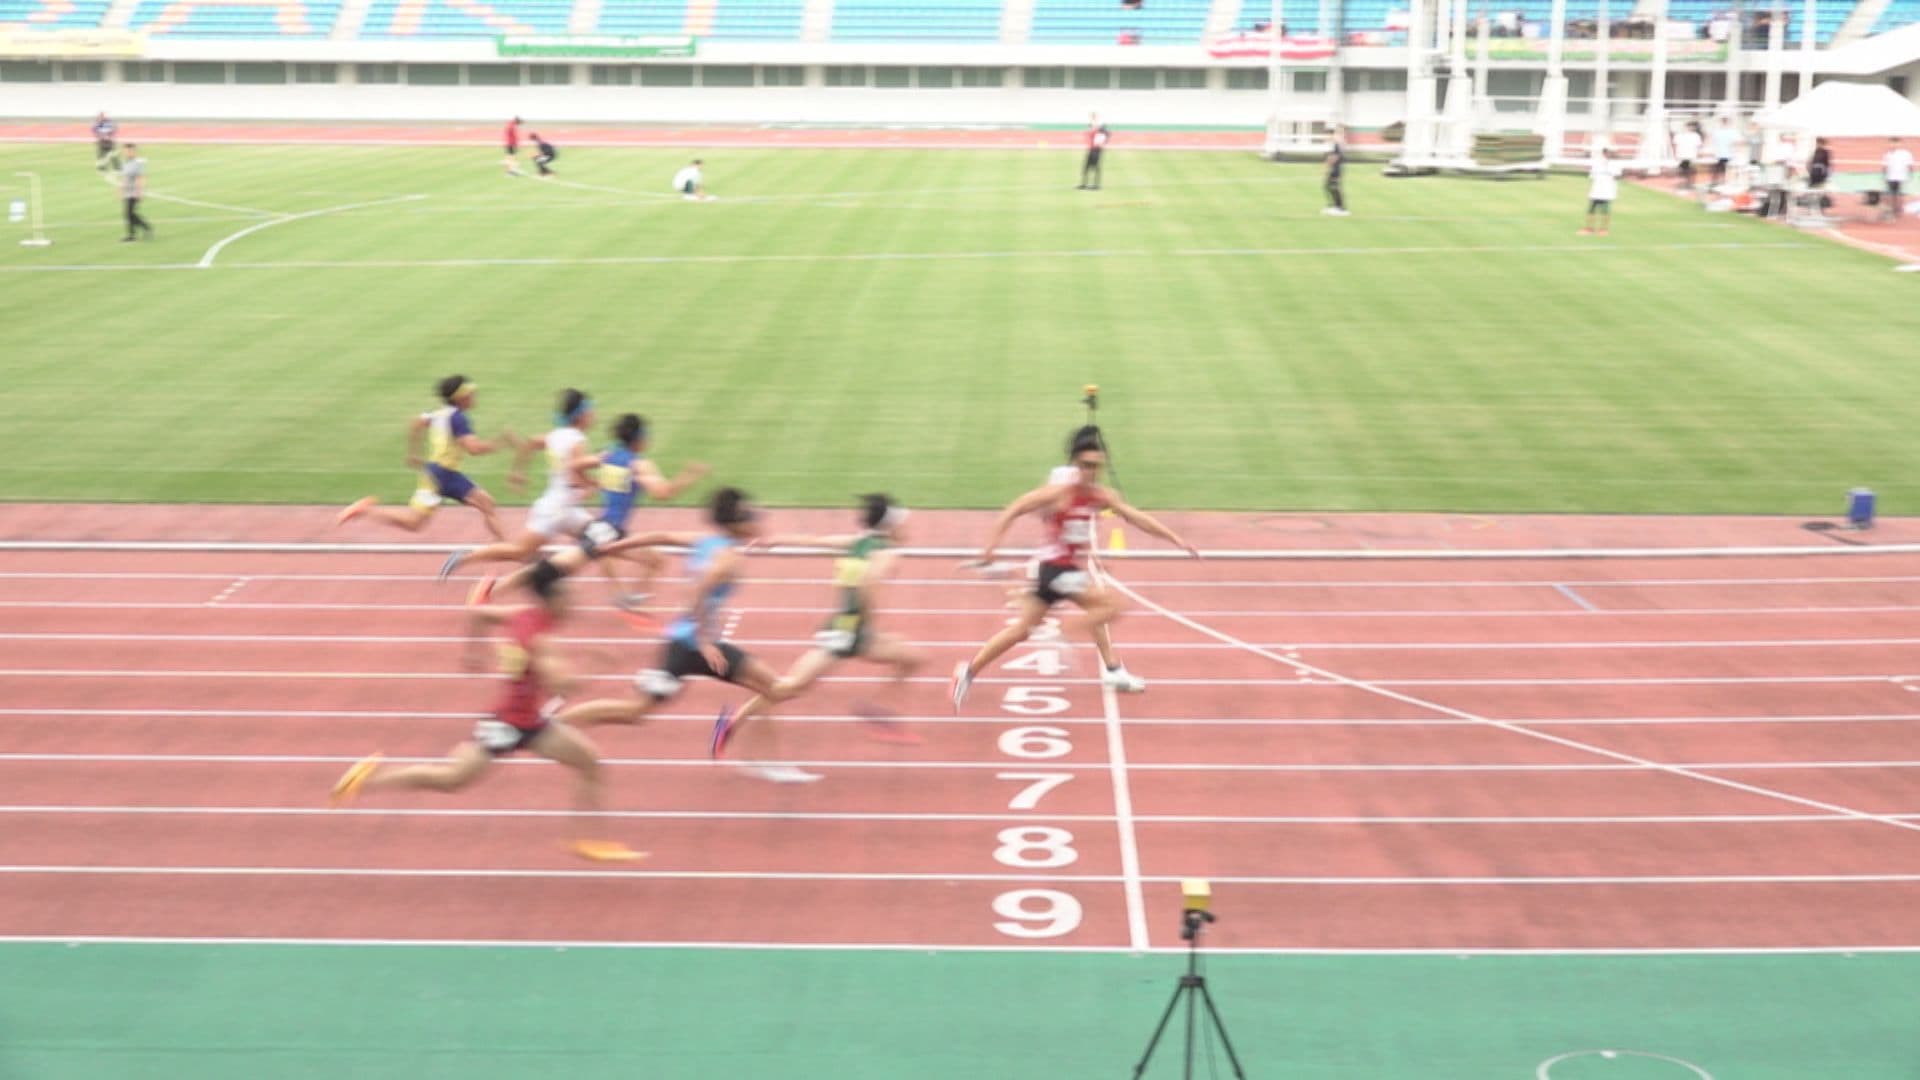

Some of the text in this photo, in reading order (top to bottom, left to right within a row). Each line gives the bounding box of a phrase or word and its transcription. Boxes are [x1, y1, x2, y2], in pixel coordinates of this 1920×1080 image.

[1001, 650, 1070, 675] 4
[1001, 686, 1071, 714] 5
[997, 726, 1073, 758] 6
[996, 773, 1075, 808] 7
[992, 826, 1078, 868] 8
[992, 889, 1082, 937] 9
